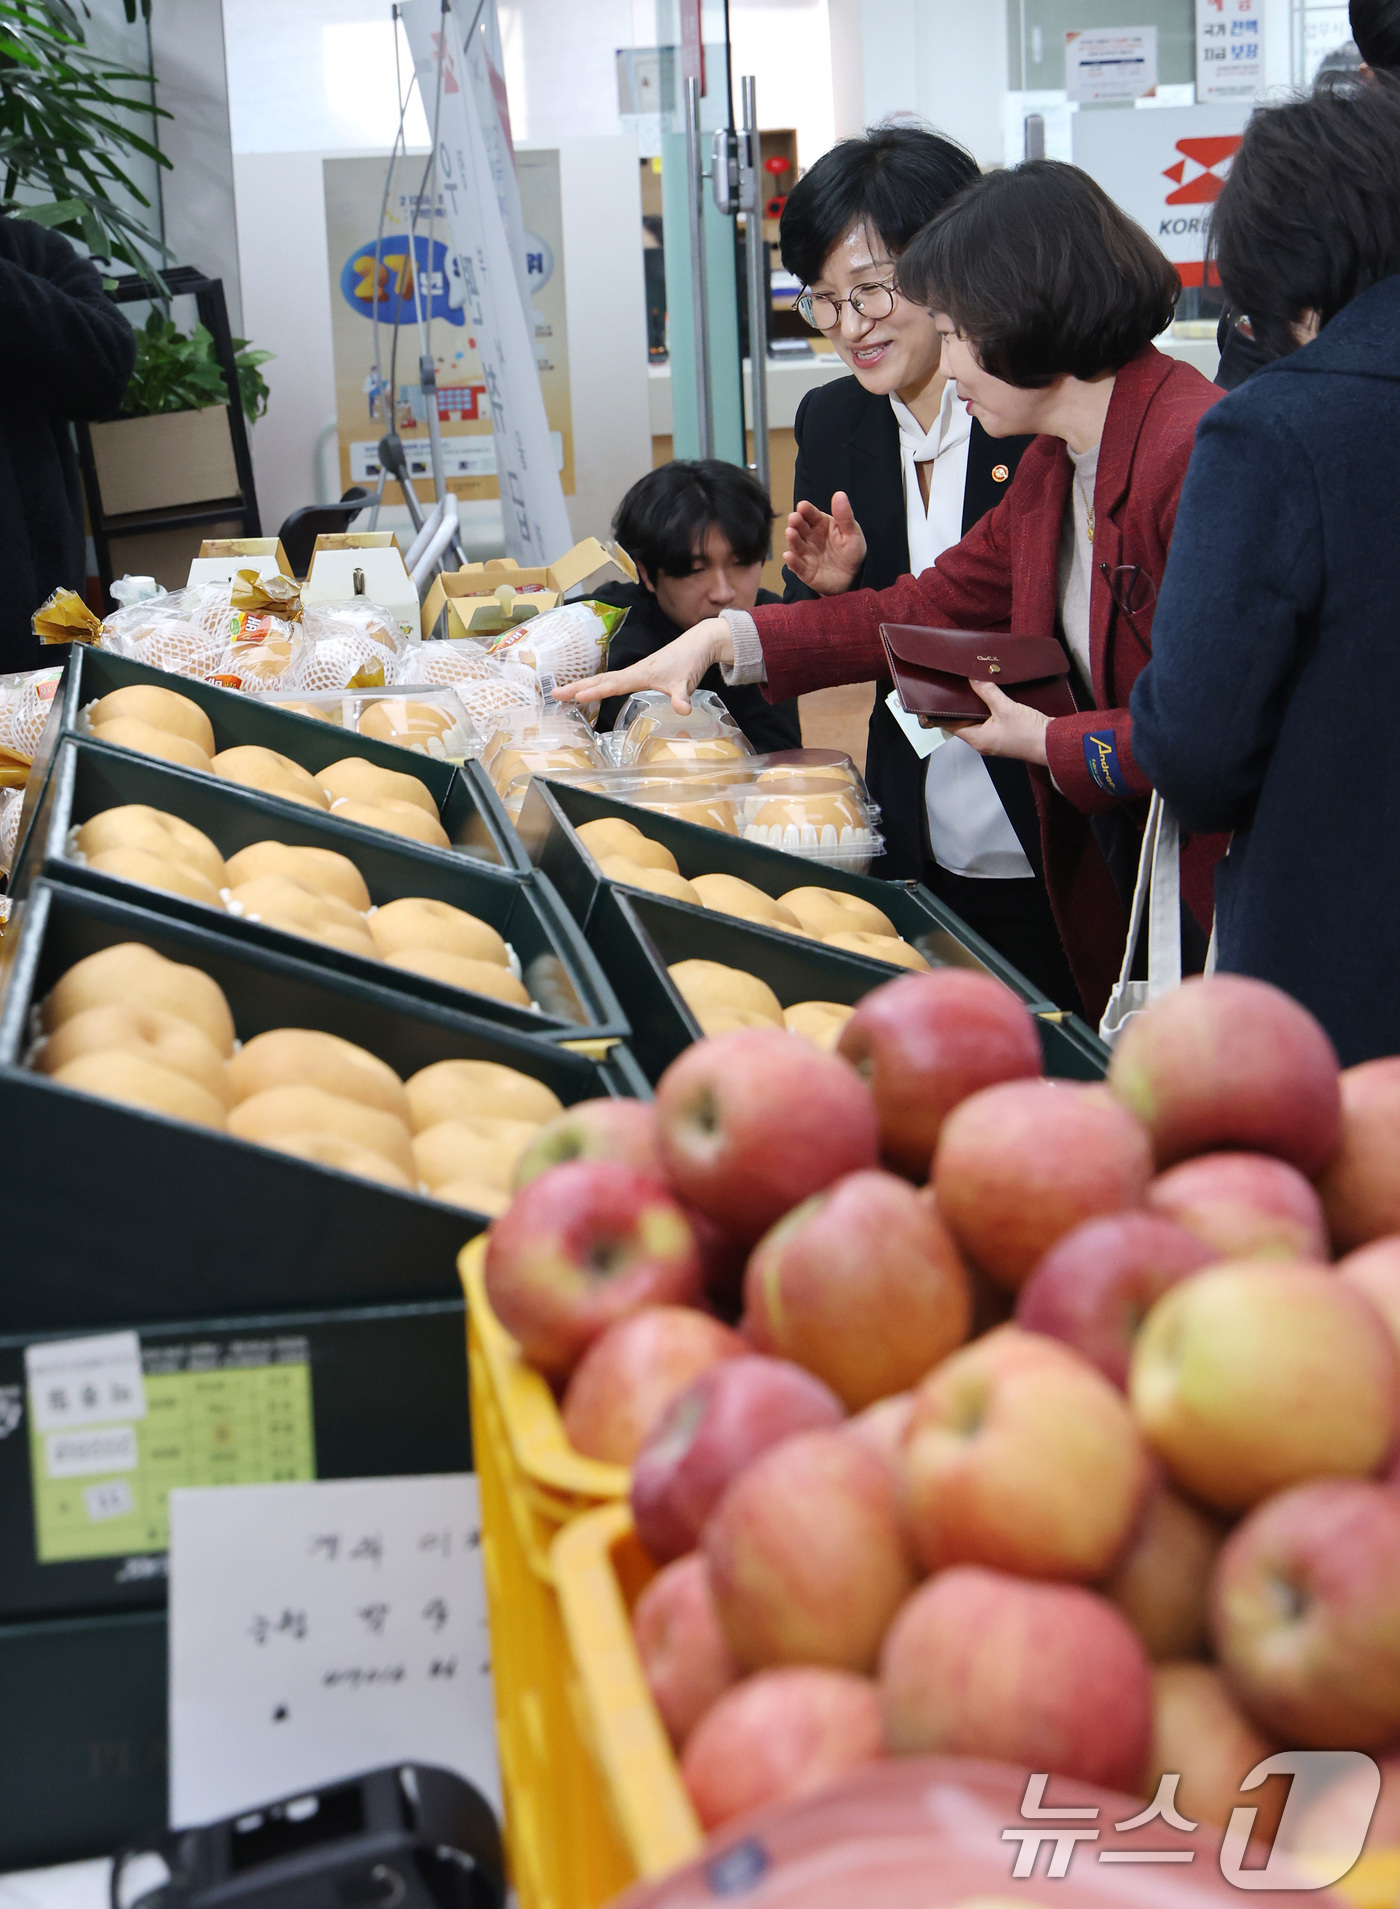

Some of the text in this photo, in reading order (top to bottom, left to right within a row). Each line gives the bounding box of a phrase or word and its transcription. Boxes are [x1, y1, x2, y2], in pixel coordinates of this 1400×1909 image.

[1203, 23, 1226, 37] 국가
[1204, 43, 1258, 61] 지급 보장
[1159, 218, 1213, 236] KORE
